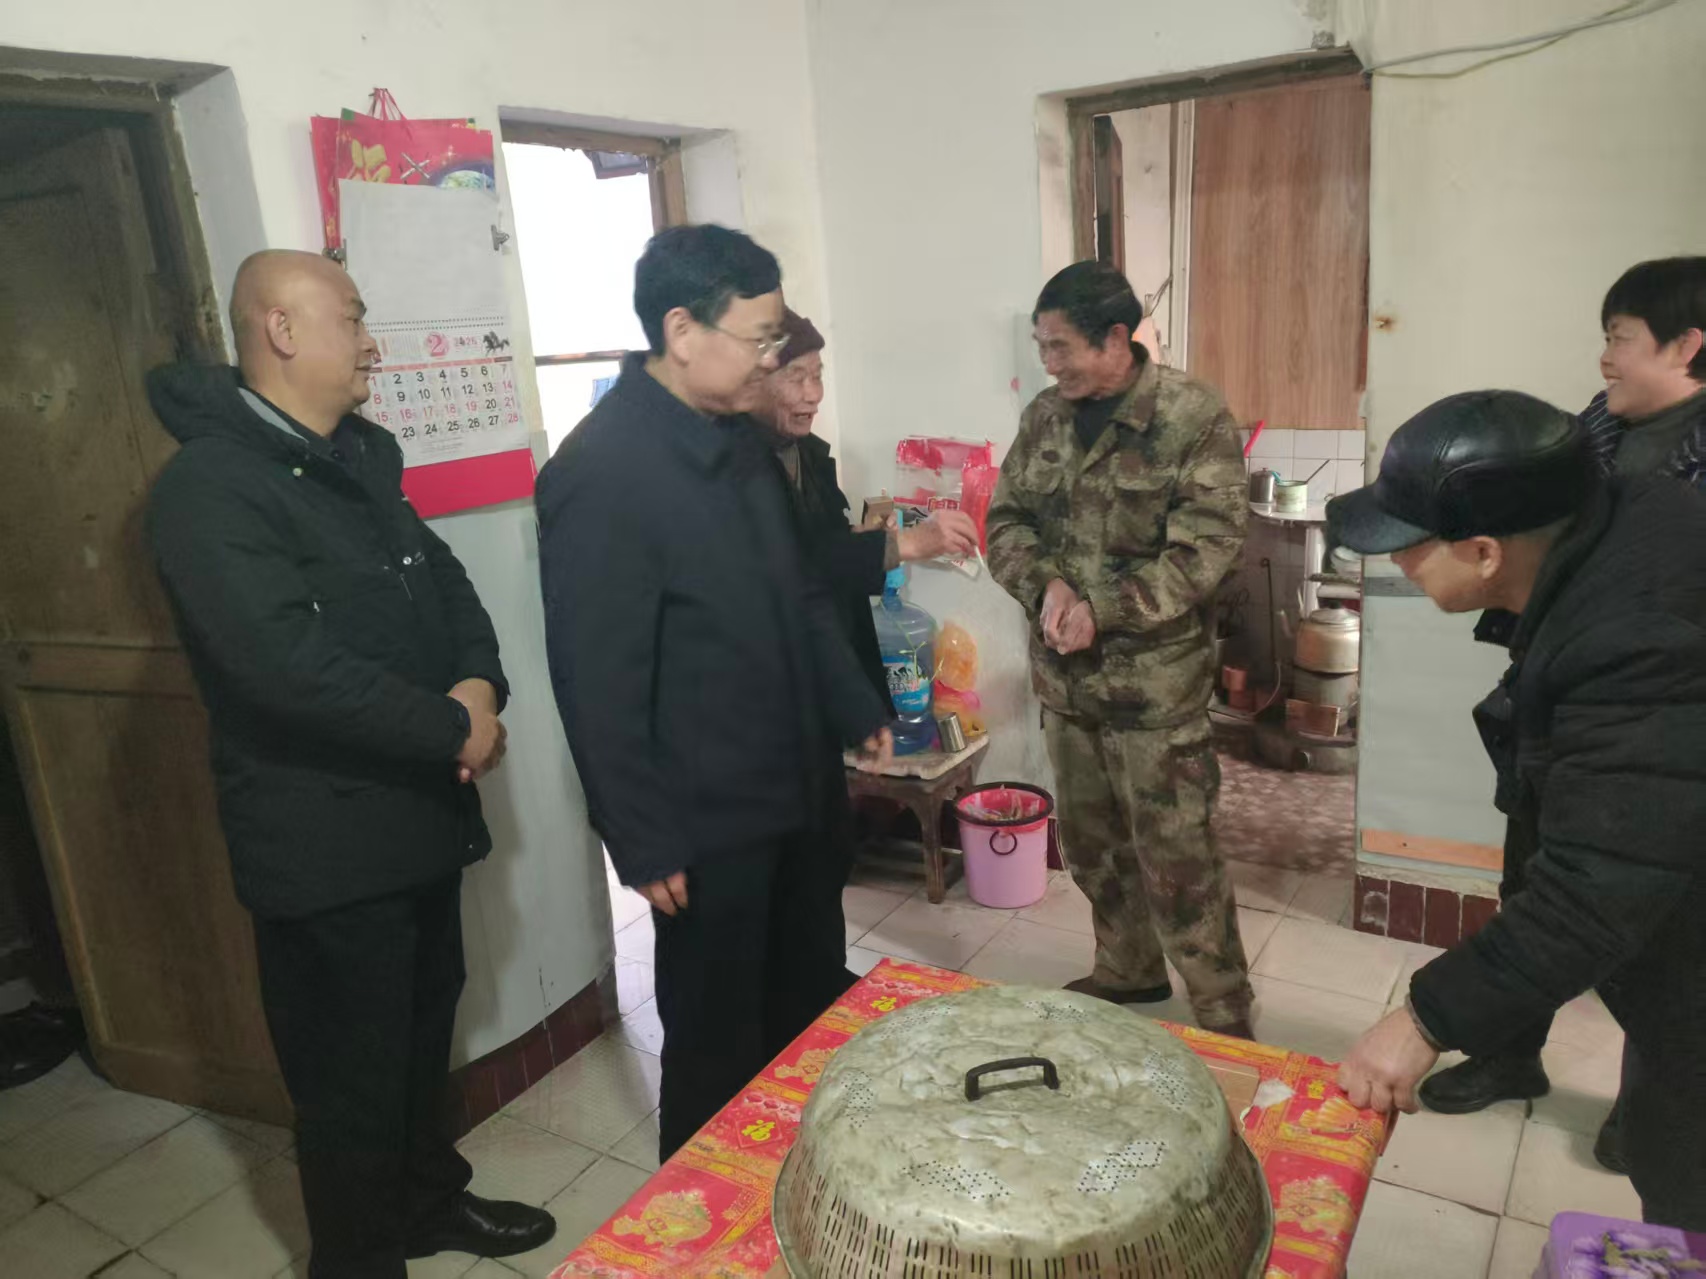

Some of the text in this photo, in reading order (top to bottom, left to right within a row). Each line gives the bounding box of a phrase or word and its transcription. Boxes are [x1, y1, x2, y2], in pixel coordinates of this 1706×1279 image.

[426, 334, 446, 357] 2
[371, 376, 376, 386] 1
[393, 374, 402, 384] 2
[416, 372, 424, 381] 3
[440, 370, 446, 379] 4
[461, 368, 468, 377] 5
[481, 366, 488, 375] 6
[374, 380, 512, 404] 8 9 10 11 12 13 14
[376, 397, 514, 422] 15 16 17 18 19 20 21
[402, 413, 518, 437] 23 24 25 26 27 28
